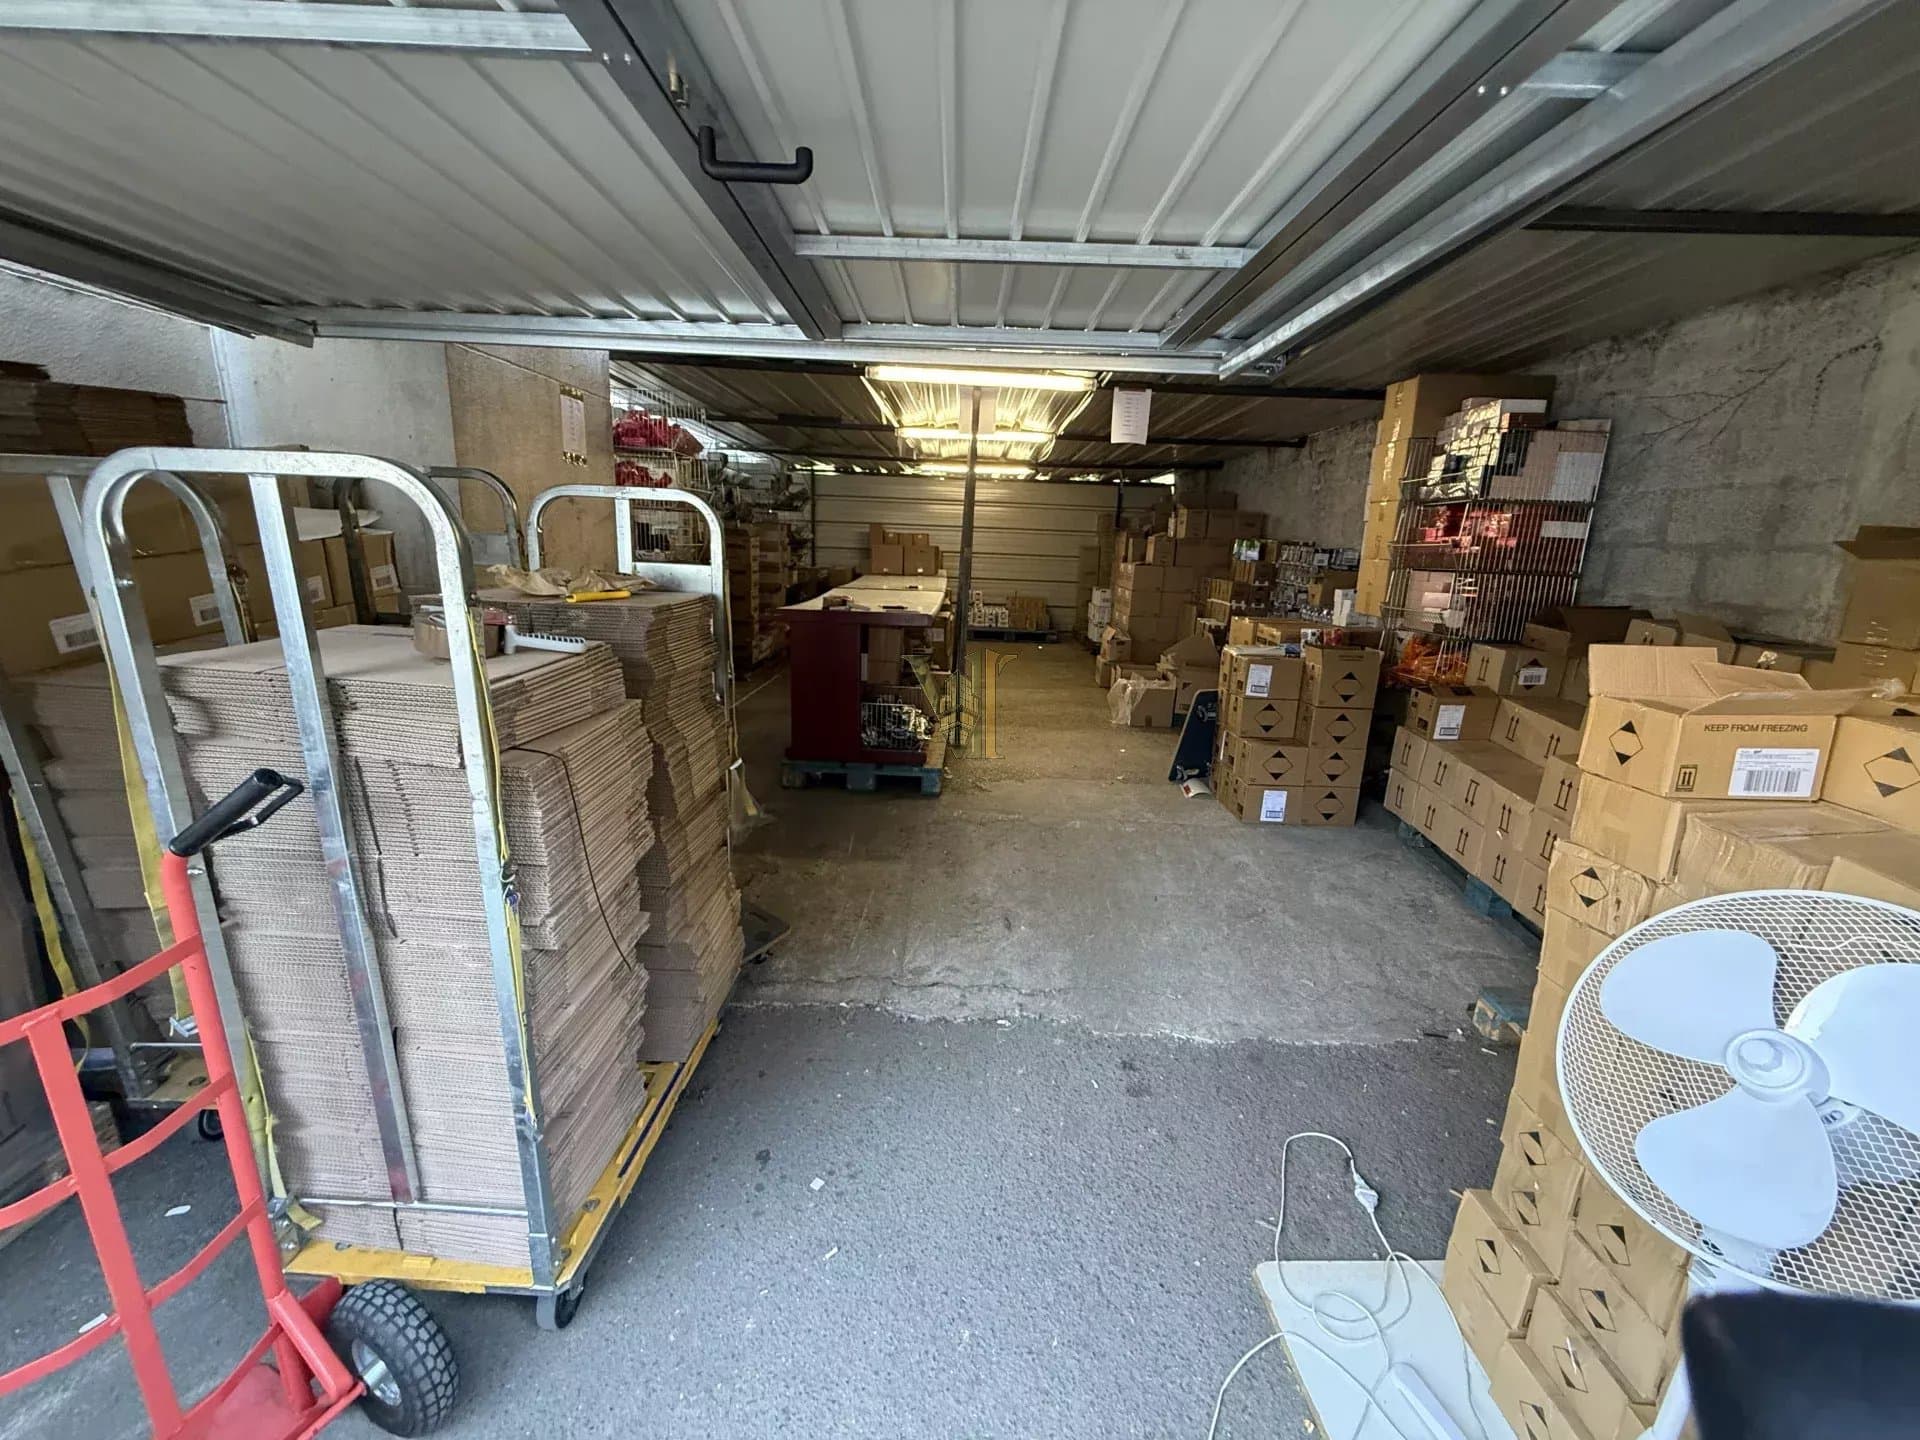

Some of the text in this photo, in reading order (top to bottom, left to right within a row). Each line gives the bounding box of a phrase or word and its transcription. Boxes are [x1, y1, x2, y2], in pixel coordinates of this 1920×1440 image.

[1704, 723, 1809, 733] KEEP FROM FREEZING
